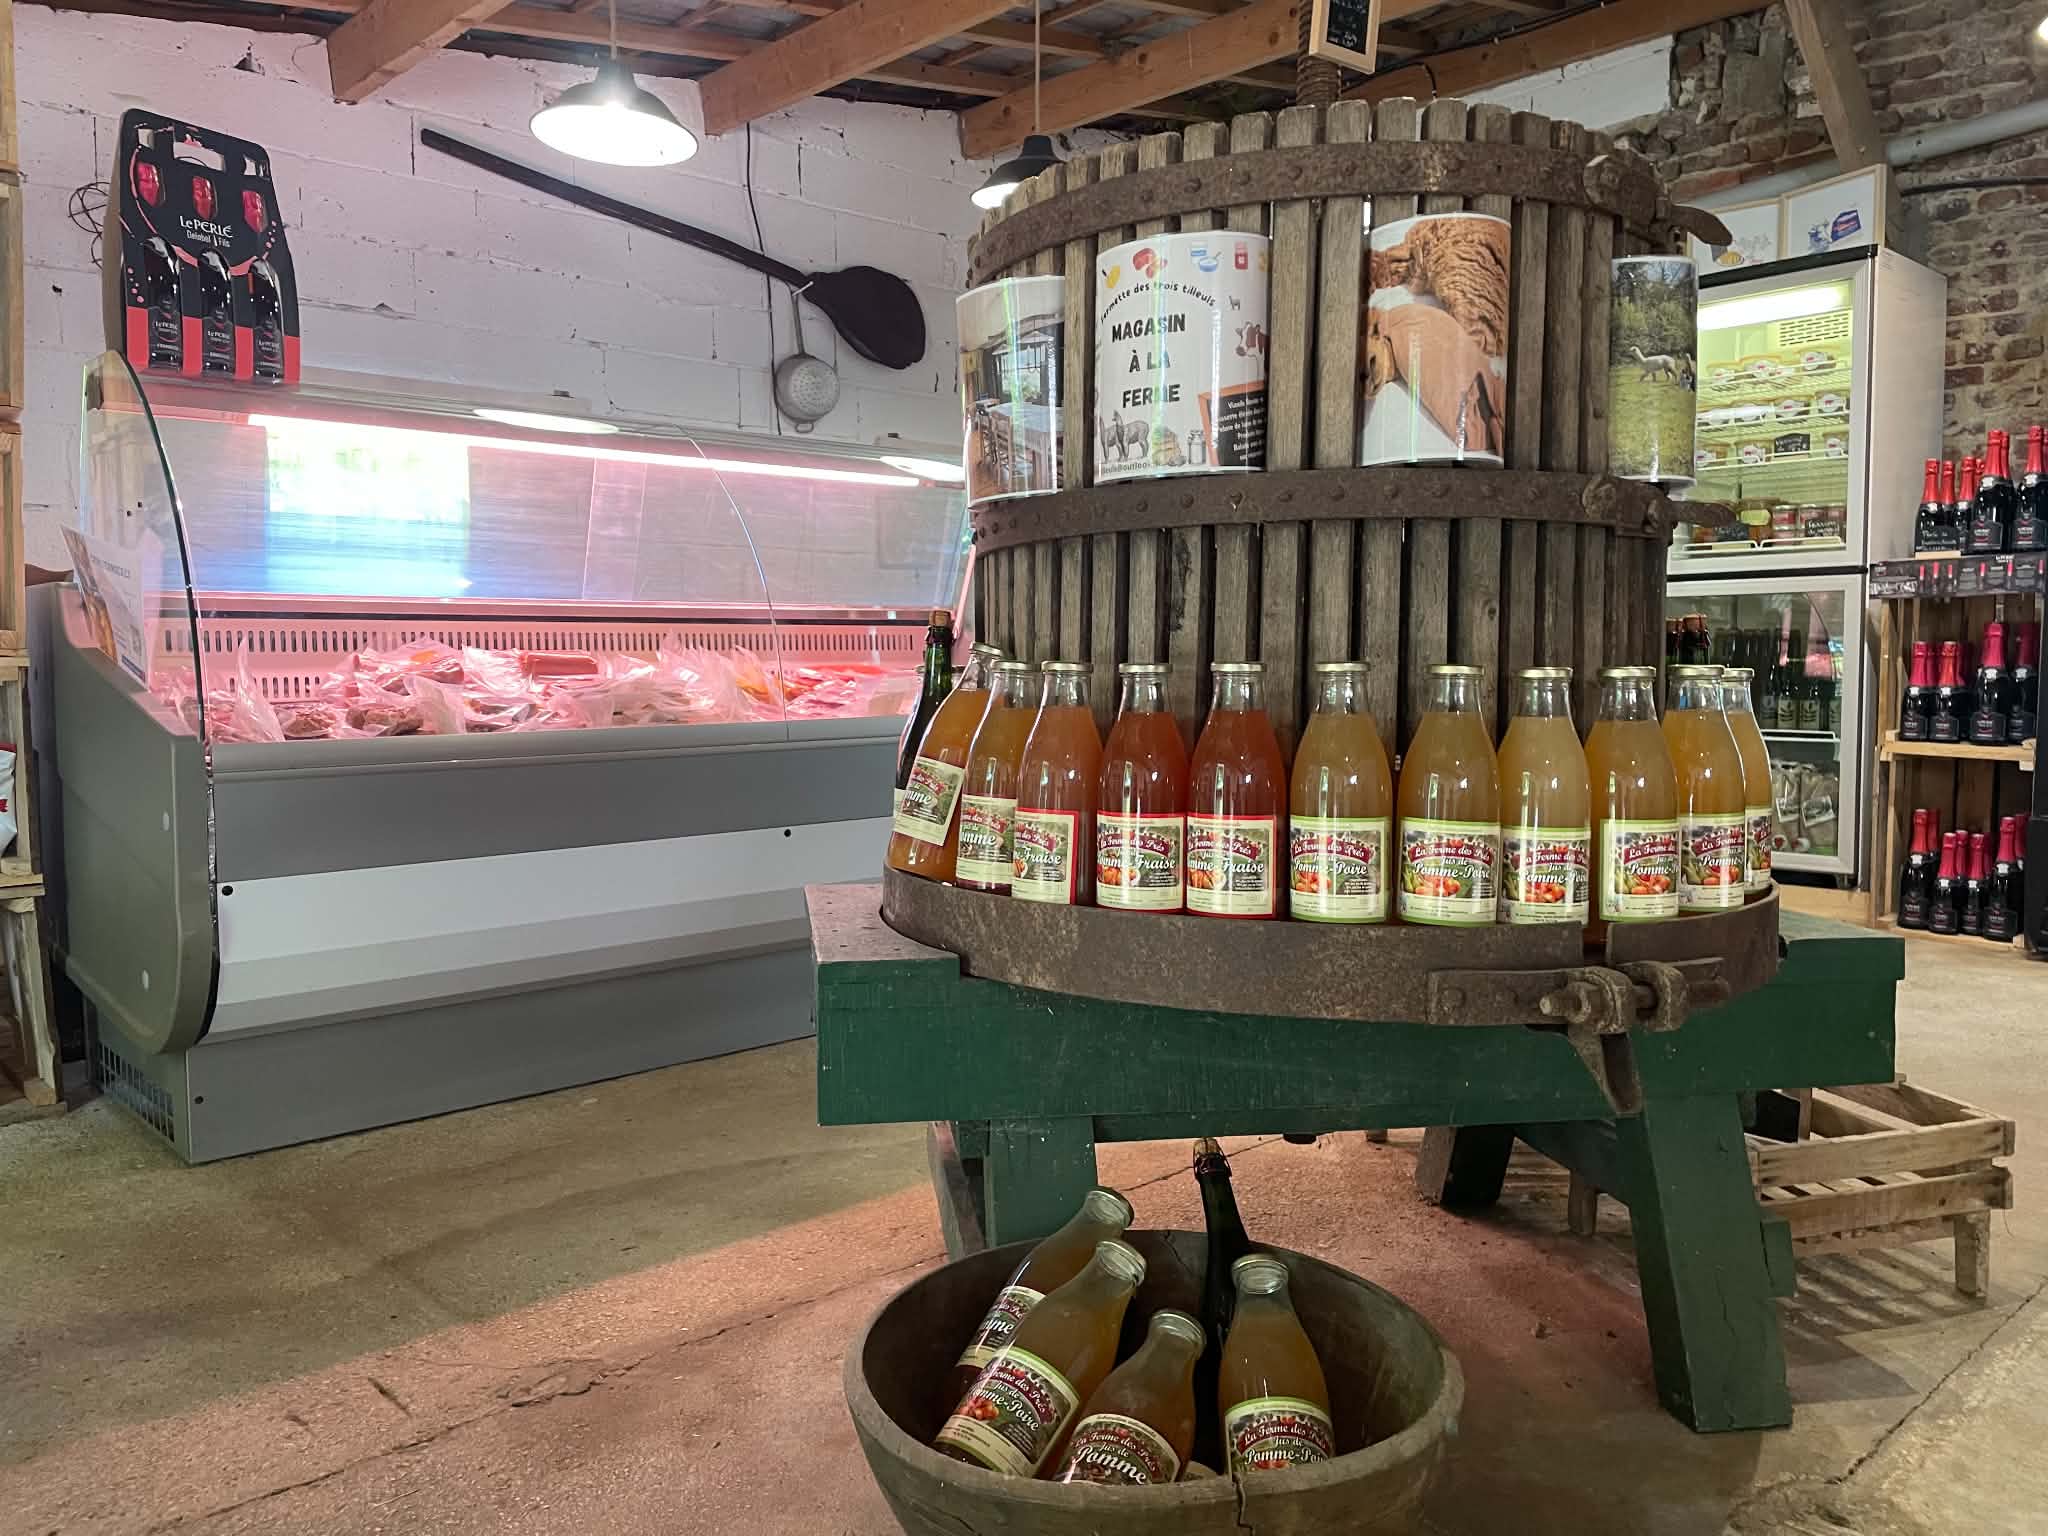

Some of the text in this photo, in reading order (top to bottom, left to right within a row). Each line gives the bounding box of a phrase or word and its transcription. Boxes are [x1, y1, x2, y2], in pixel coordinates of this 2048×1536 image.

[1134, 283, 1150, 294] des
[1183, 285, 1216, 307] tilleuls
[1112, 314, 1186, 343] MAGASIN
[1128, 349, 1171, 373] À LA
[1145, 839, 1165, 852] Prés
[1231, 841, 1252, 855] Prés
[1345, 844, 1365, 858] Prés
[1415, 846, 1426, 857] La
[1428, 844, 1456, 855] Ferme
[1457, 846, 1472, 855] des
[1629, 848, 1641, 858] La
[1702, 840, 1714, 851] La
[1441, 854, 1468, 866] Jus de
[994, 1381, 1020, 1399] Jus de
[1015, 1378, 1029, 1392] des
[1029, 1390, 1046, 1413] Prés
[1089, 1431, 1120, 1443] Ferme
[1120, 1438, 1137, 1450] des
[1244, 1428, 1257, 1446] La
[1258, 1423, 1290, 1437] Ferme
[1290, 1423, 1306, 1436] des
[1272, 1436, 1305, 1448] Jus de
[1099, 1441, 1130, 1458] Jus de
[1073, 1446, 1147, 1485] Pomme
